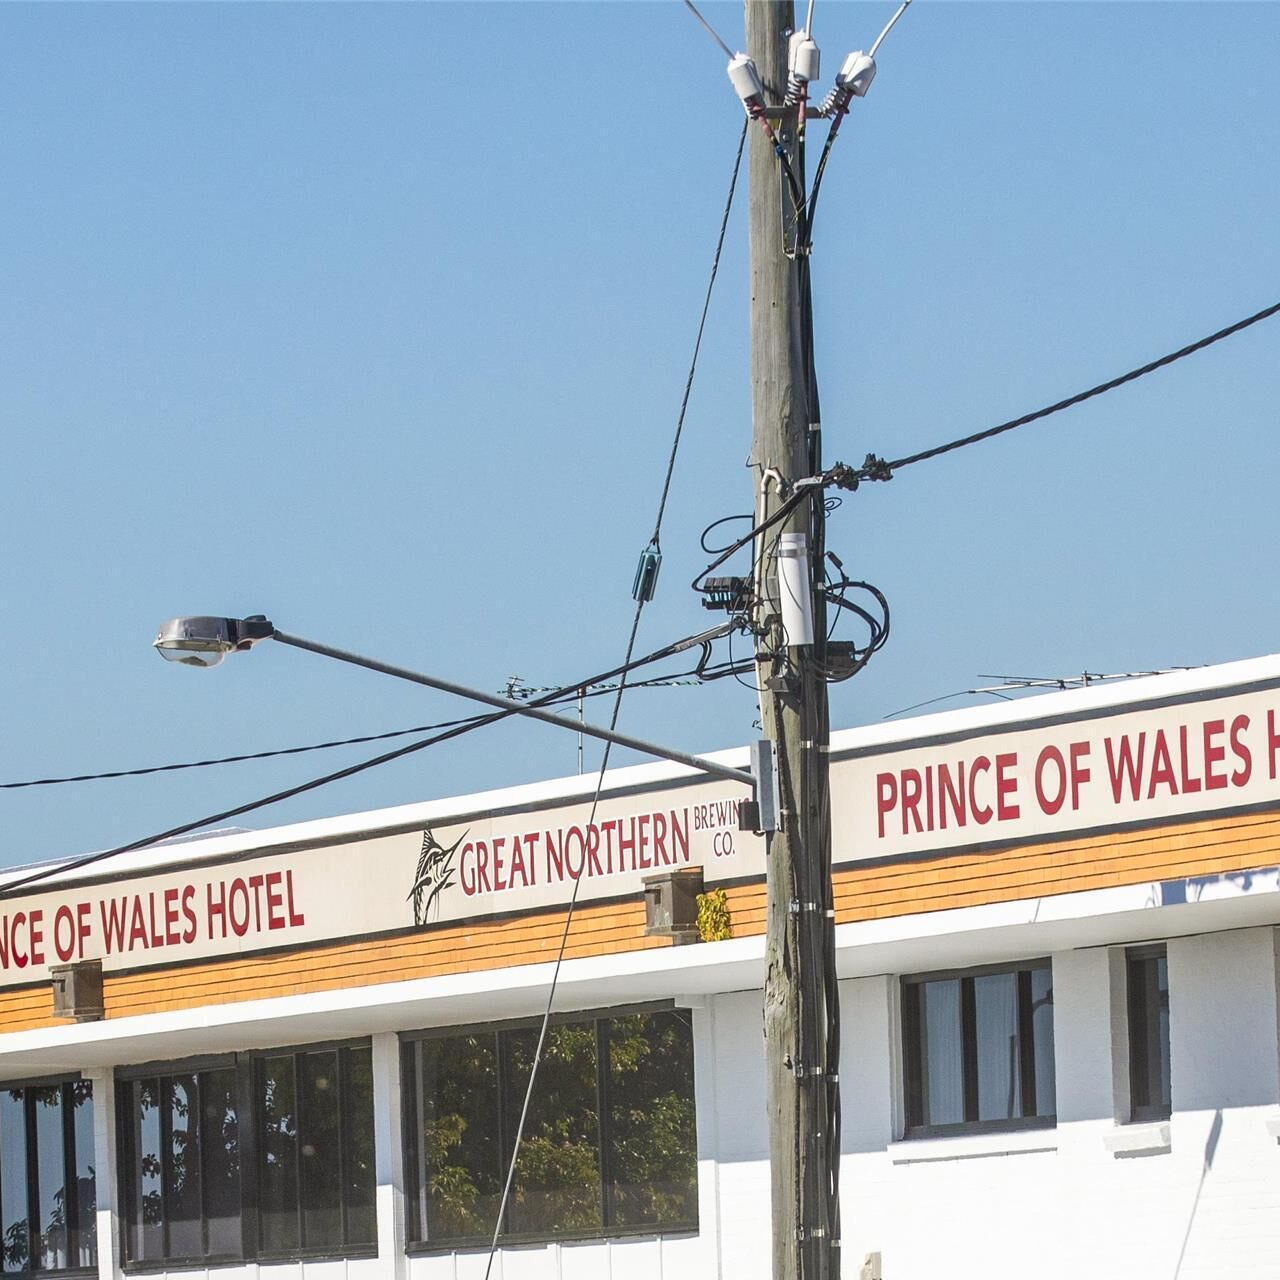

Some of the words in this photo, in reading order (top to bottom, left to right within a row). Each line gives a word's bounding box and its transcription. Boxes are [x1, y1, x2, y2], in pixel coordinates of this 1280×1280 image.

[694, 797, 750, 831] BREWIN
[876, 752, 1020, 838] PRINCE
[1034, 741, 1090, 816] OF
[1103, 714, 1252, 804] WALES
[460, 833, 539, 896] GREAT
[545, 808, 690, 883] NORTHERN
[713, 831, 735, 857] CO.
[54, 903, 91, 963] OF
[100, 885, 197, 955] WALES
[206, 870, 305, 940] HOTEL
